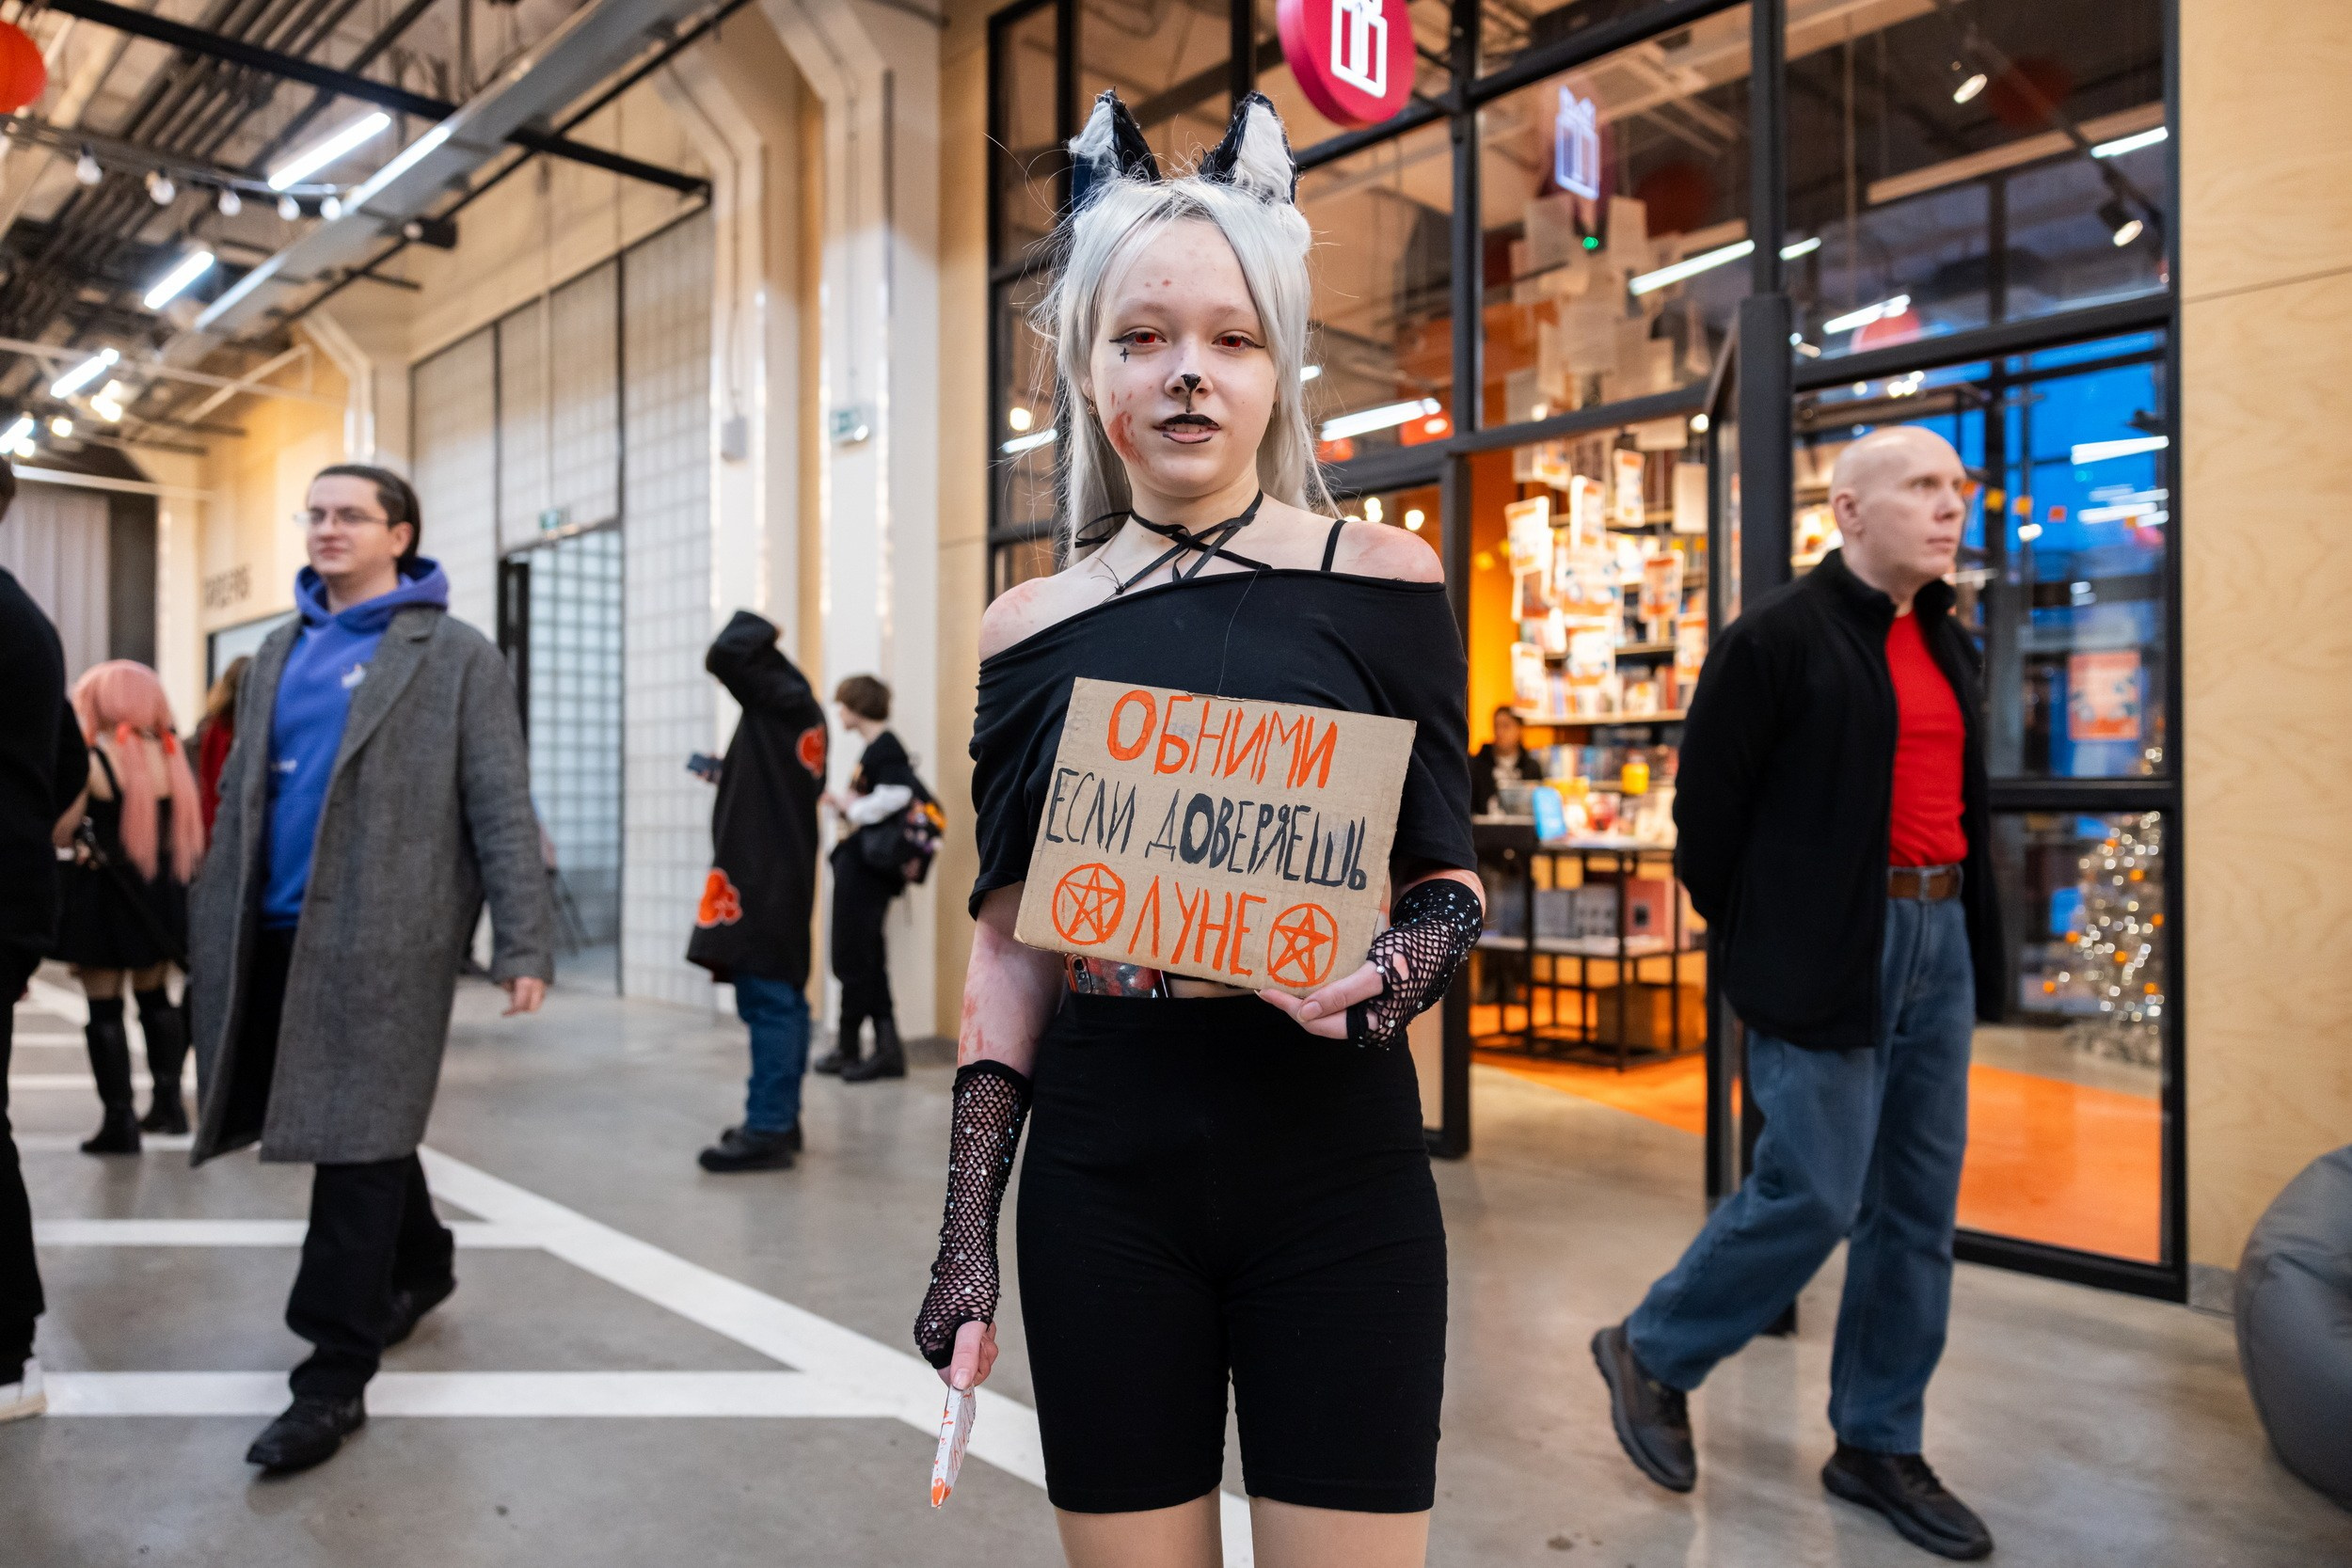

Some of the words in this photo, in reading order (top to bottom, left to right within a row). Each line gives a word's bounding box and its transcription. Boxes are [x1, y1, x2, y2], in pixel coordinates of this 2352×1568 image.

[1107, 689, 1338, 789] ОБНИМИ
[1046, 768, 1136, 854] ЕСЛИ
[1144, 789, 1367, 891] ДОВЕРЯЕШЬ
[1128, 875, 1267, 976] ЛУНЕ
